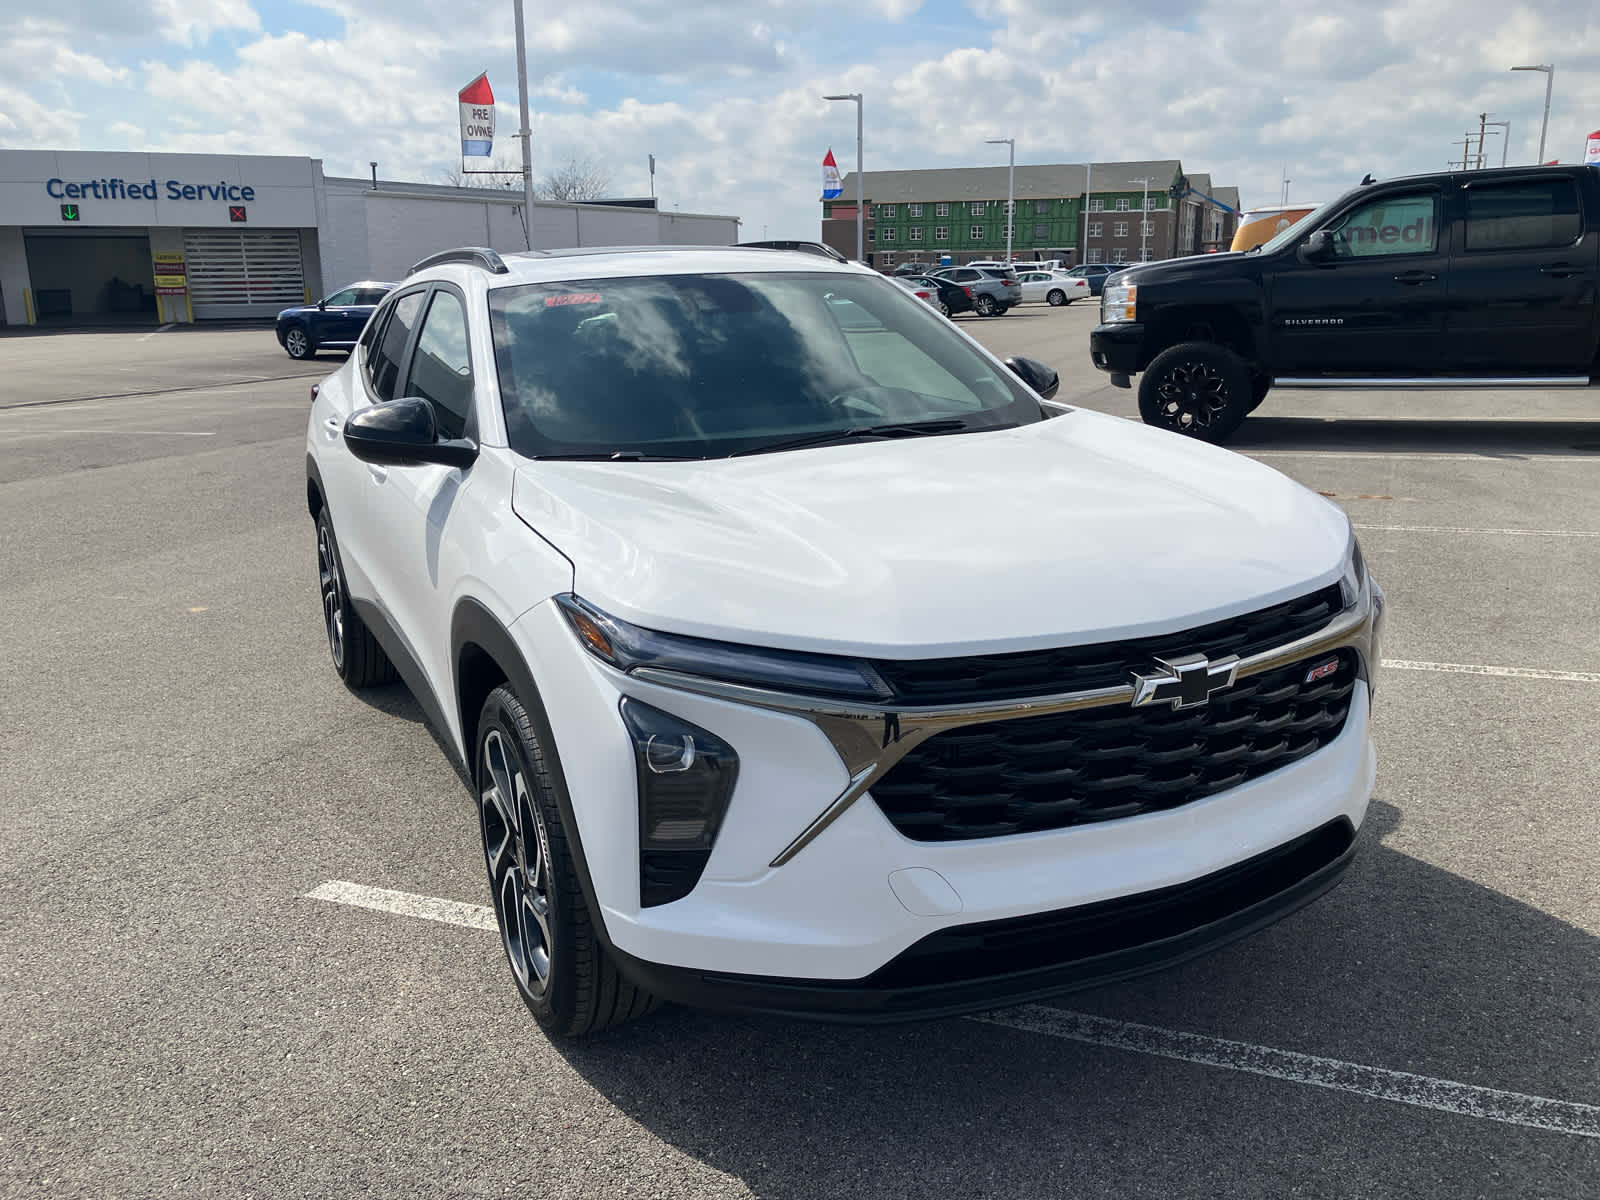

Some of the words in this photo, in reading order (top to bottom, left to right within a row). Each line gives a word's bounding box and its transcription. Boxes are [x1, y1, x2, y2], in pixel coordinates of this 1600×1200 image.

[472, 108, 488, 120] PRE
[46, 178, 158, 200] Certified
[166, 180, 255, 201] Service
[1284, 318, 1344, 326] SILVERADO
